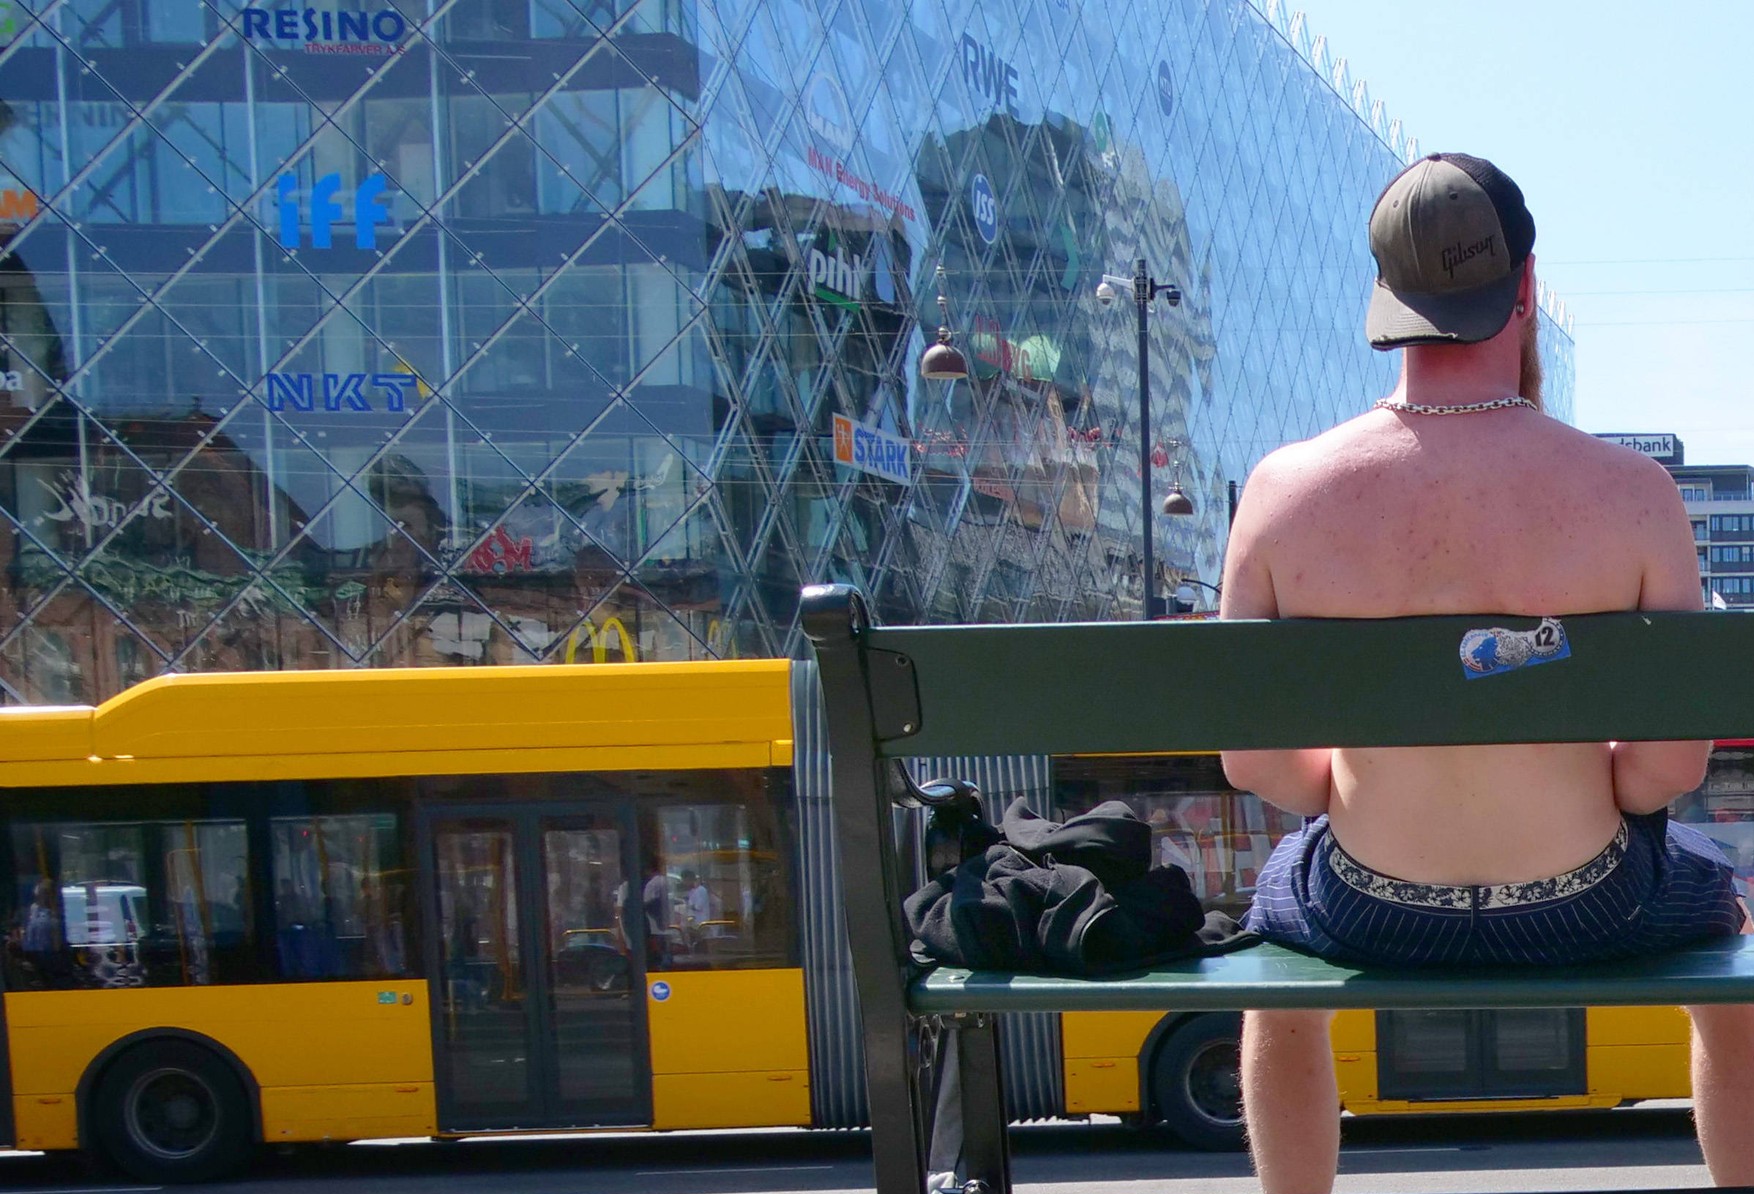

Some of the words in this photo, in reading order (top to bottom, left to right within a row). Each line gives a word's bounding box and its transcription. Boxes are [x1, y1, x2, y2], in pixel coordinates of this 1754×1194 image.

[243, 8, 406, 42] RESINO
[962, 31, 1020, 119] RWE
[808, 146, 833, 178] MAN
[836, 161, 871, 202] Energy
[873, 183, 916, 222] Solutions
[974, 190, 995, 226] ISS
[278, 172, 390, 250] iff
[807, 246, 861, 301] pihl
[1442, 234, 1496, 280] Gibson
[267, 373, 418, 413] NKT
[854, 427, 909, 480] STARK
[1535, 626, 1555, 647] 12
